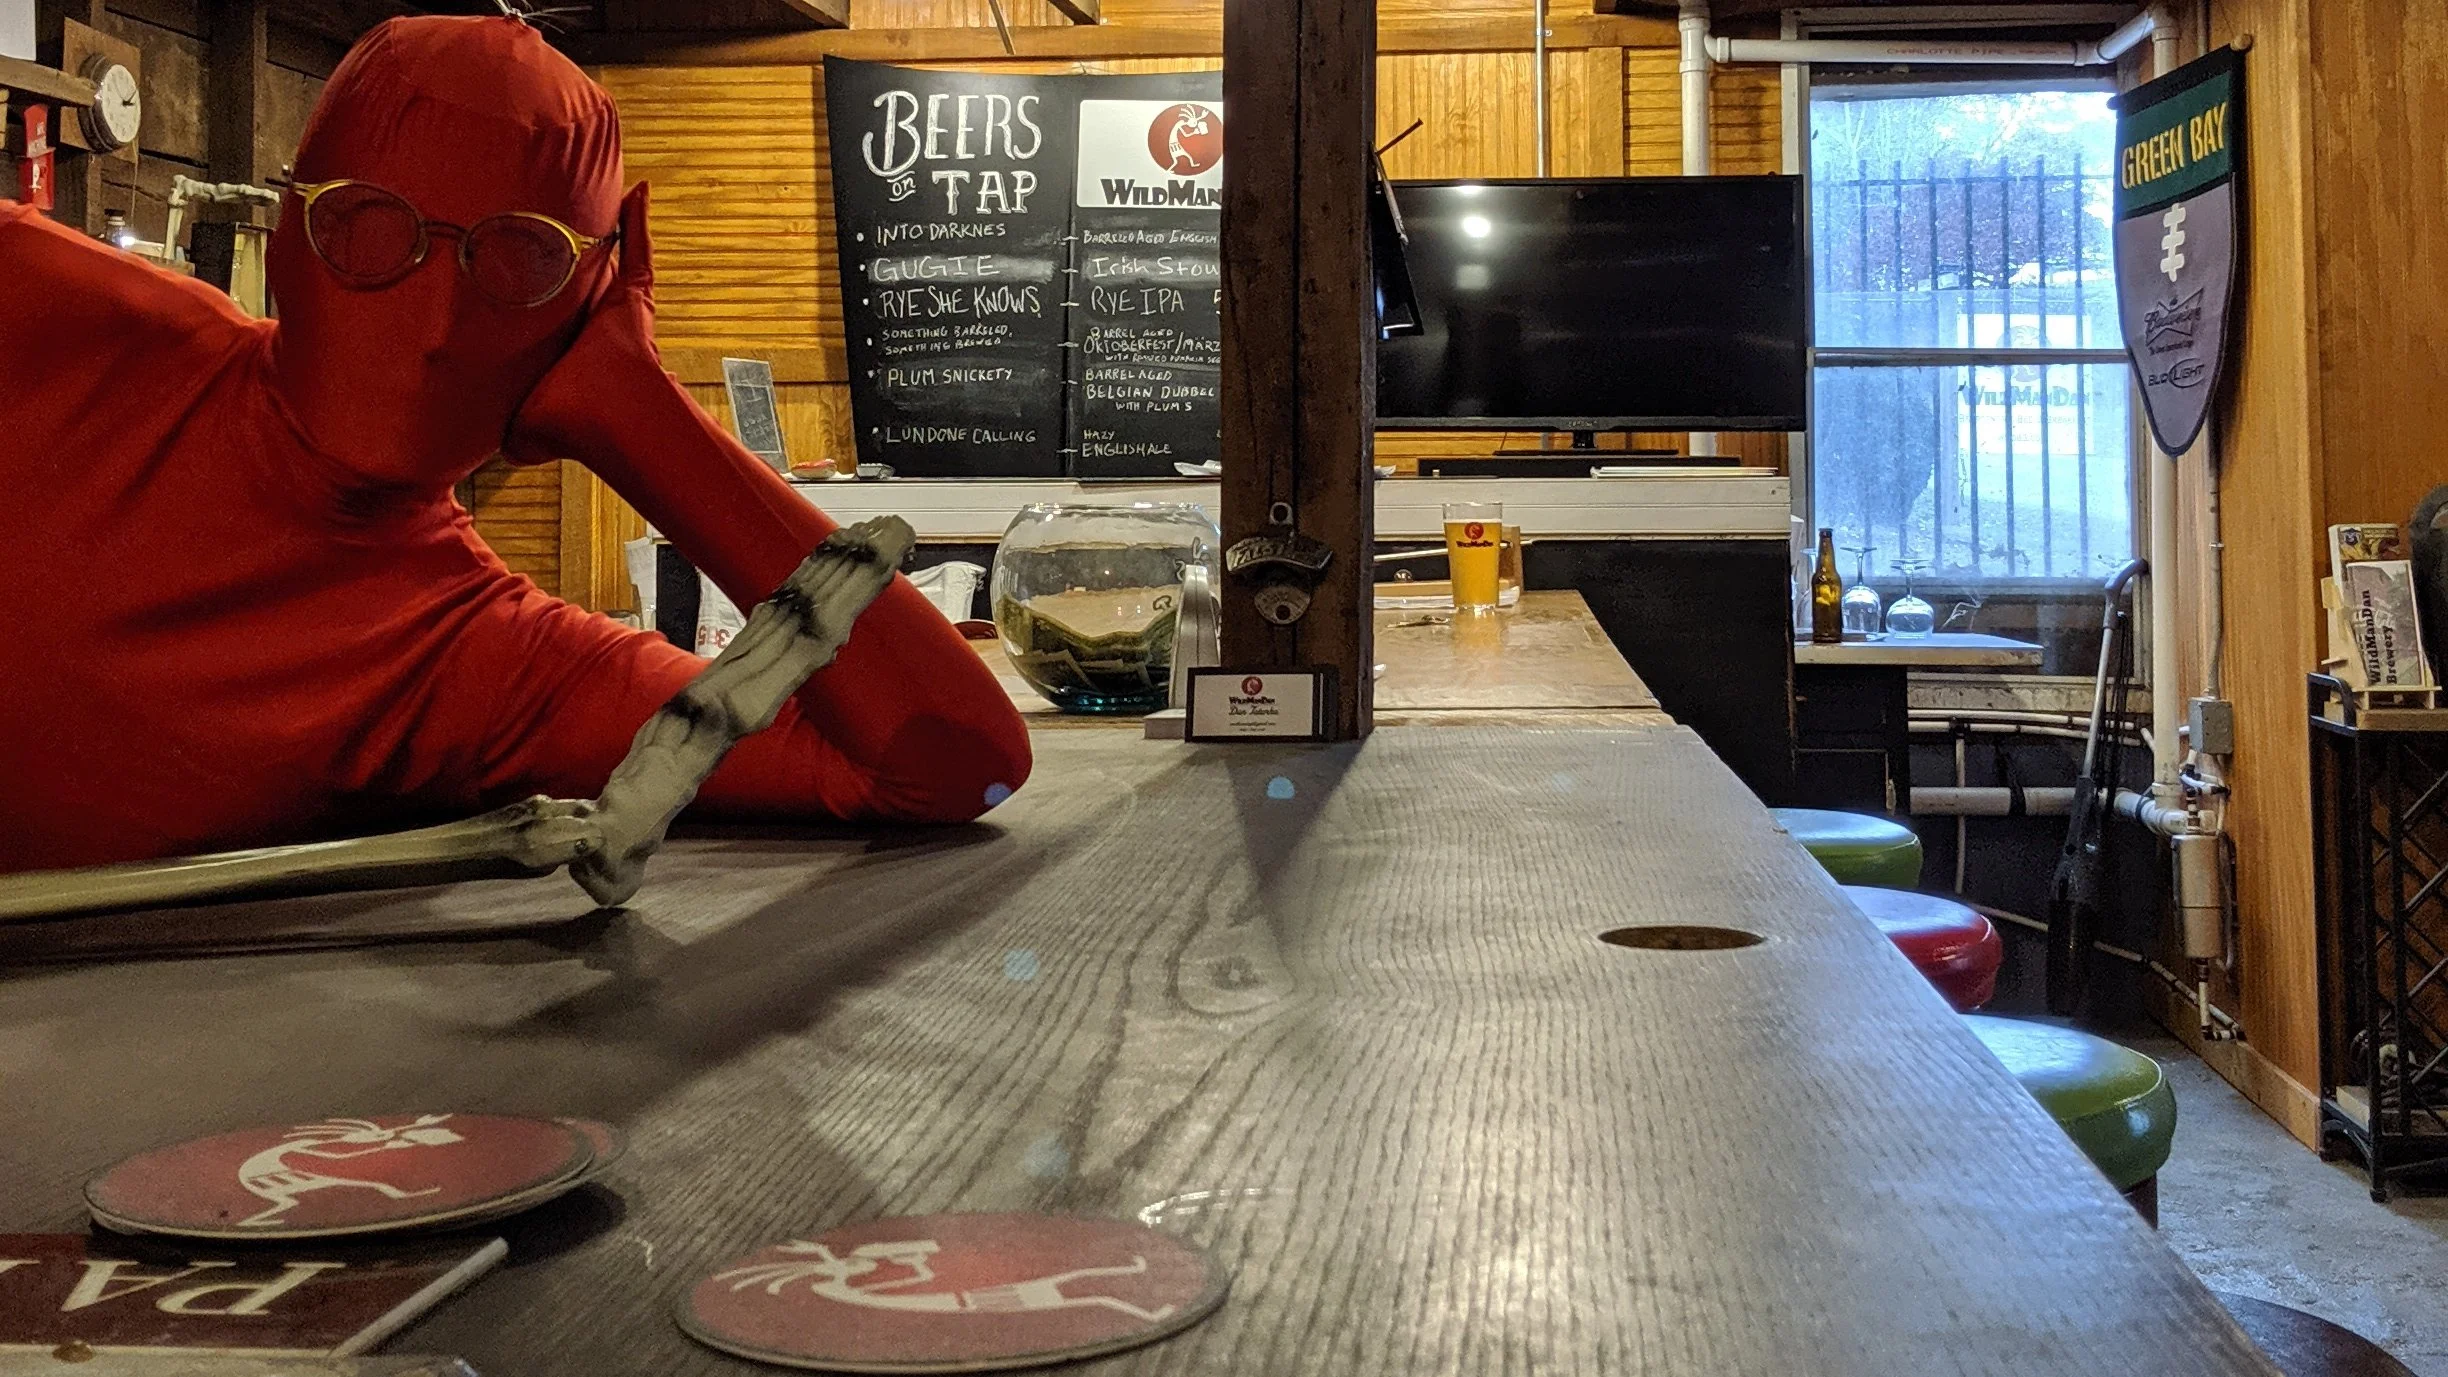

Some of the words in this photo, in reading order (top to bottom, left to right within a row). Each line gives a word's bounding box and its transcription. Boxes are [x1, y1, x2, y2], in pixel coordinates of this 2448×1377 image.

[862, 90, 1042, 177] BEERS
[2122, 124, 2185, 190] GREEN
[2190, 101, 2227, 163] BAY
[931, 170, 1037, 216] TAP
[877, 225, 923, 247] INTO
[930, 222, 1006, 241] DARKNES
[1092, 256, 1150, 278] Irish
[880, 288, 925, 319] RYE
[927, 285, 969, 318] SHE
[973, 285, 1042, 319] KNOWS
[1091, 285, 1136, 315] RYE
[1139, 287, 1184, 315] IPA
[882, 325, 948, 341] SOMETHING
[885, 341, 951, 356] SOMETHING
[888, 368, 935, 388] PLUM
[942, 367, 1013, 384] SNICKETY
[1085, 367, 1136, 381] BARREL
[1138, 369, 1173, 381] AGED
[1086, 383, 1154, 400] BELGIAN
[1160, 385, 1216, 399] DUBBEL
[1115, 401, 1140, 411] WITH
[886, 426, 968, 444] LUNDONE
[972, 428, 1036, 444] CALLING
[1083, 429, 1115, 440] HAZY
[1082, 442, 1146, 458] ENGLISH
[1147, 442, 1172, 455] ALE
[2361, 589, 2382, 685] WildManDan
[2383, 625, 2398, 685] Brewery
[0, 1258, 347, 1316] PA
